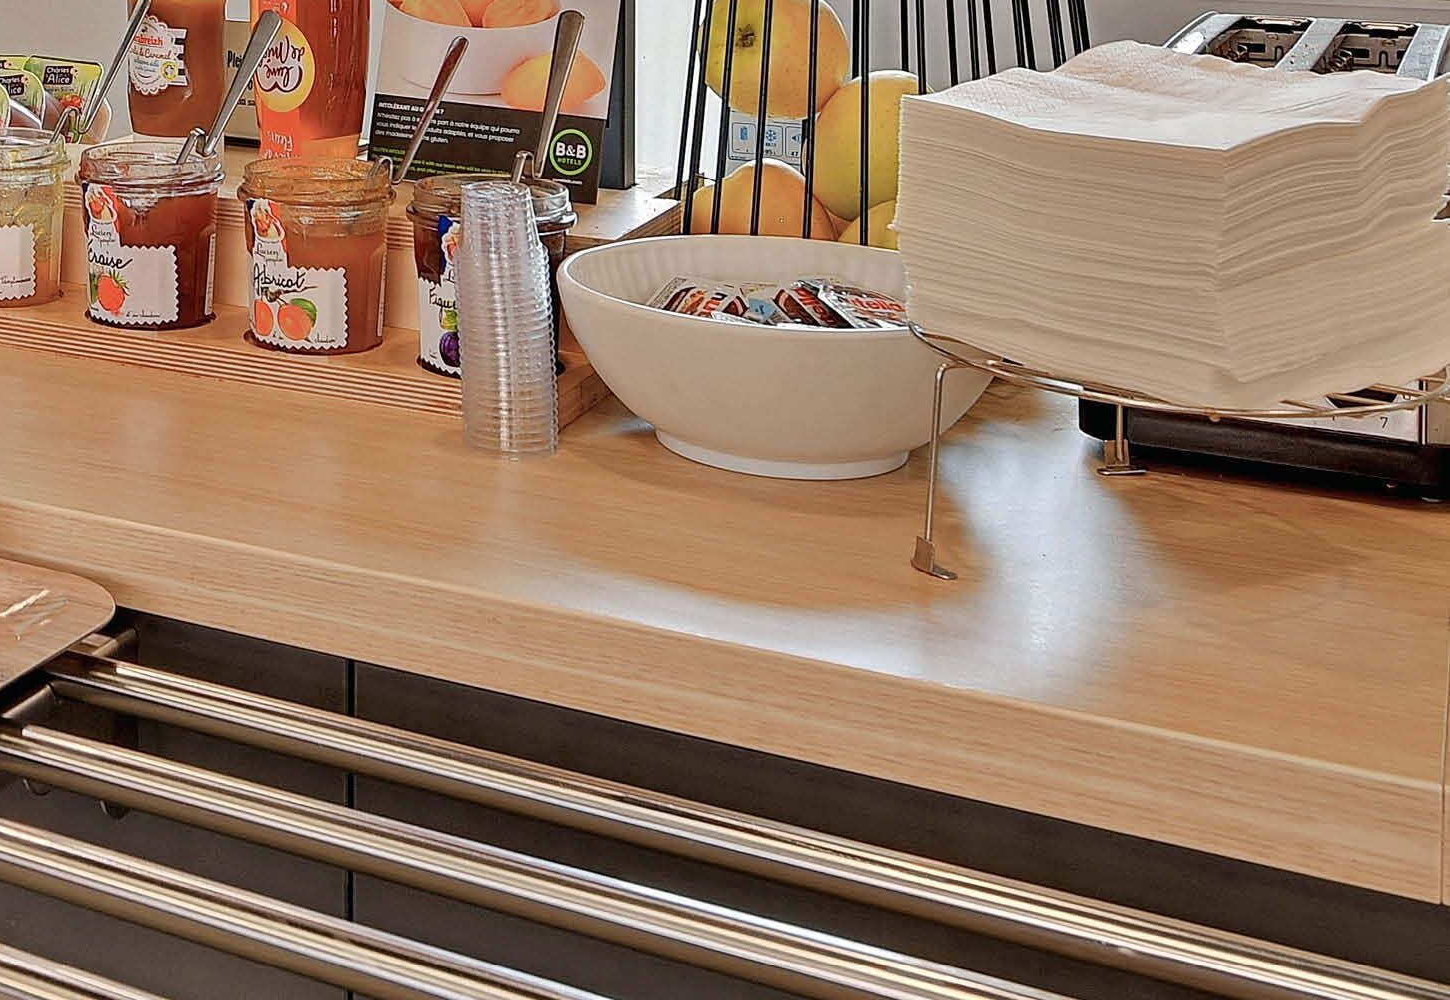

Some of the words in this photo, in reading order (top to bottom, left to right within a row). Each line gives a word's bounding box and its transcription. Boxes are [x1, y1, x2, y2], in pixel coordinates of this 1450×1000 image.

[47, 74, 70, 84] Alice
[555, 142, 586, 159] B&B
[557, 157, 581, 166] HOTELS
[254, 263, 306, 296] Abricot
[1380, 416, 1388, 428] 7
